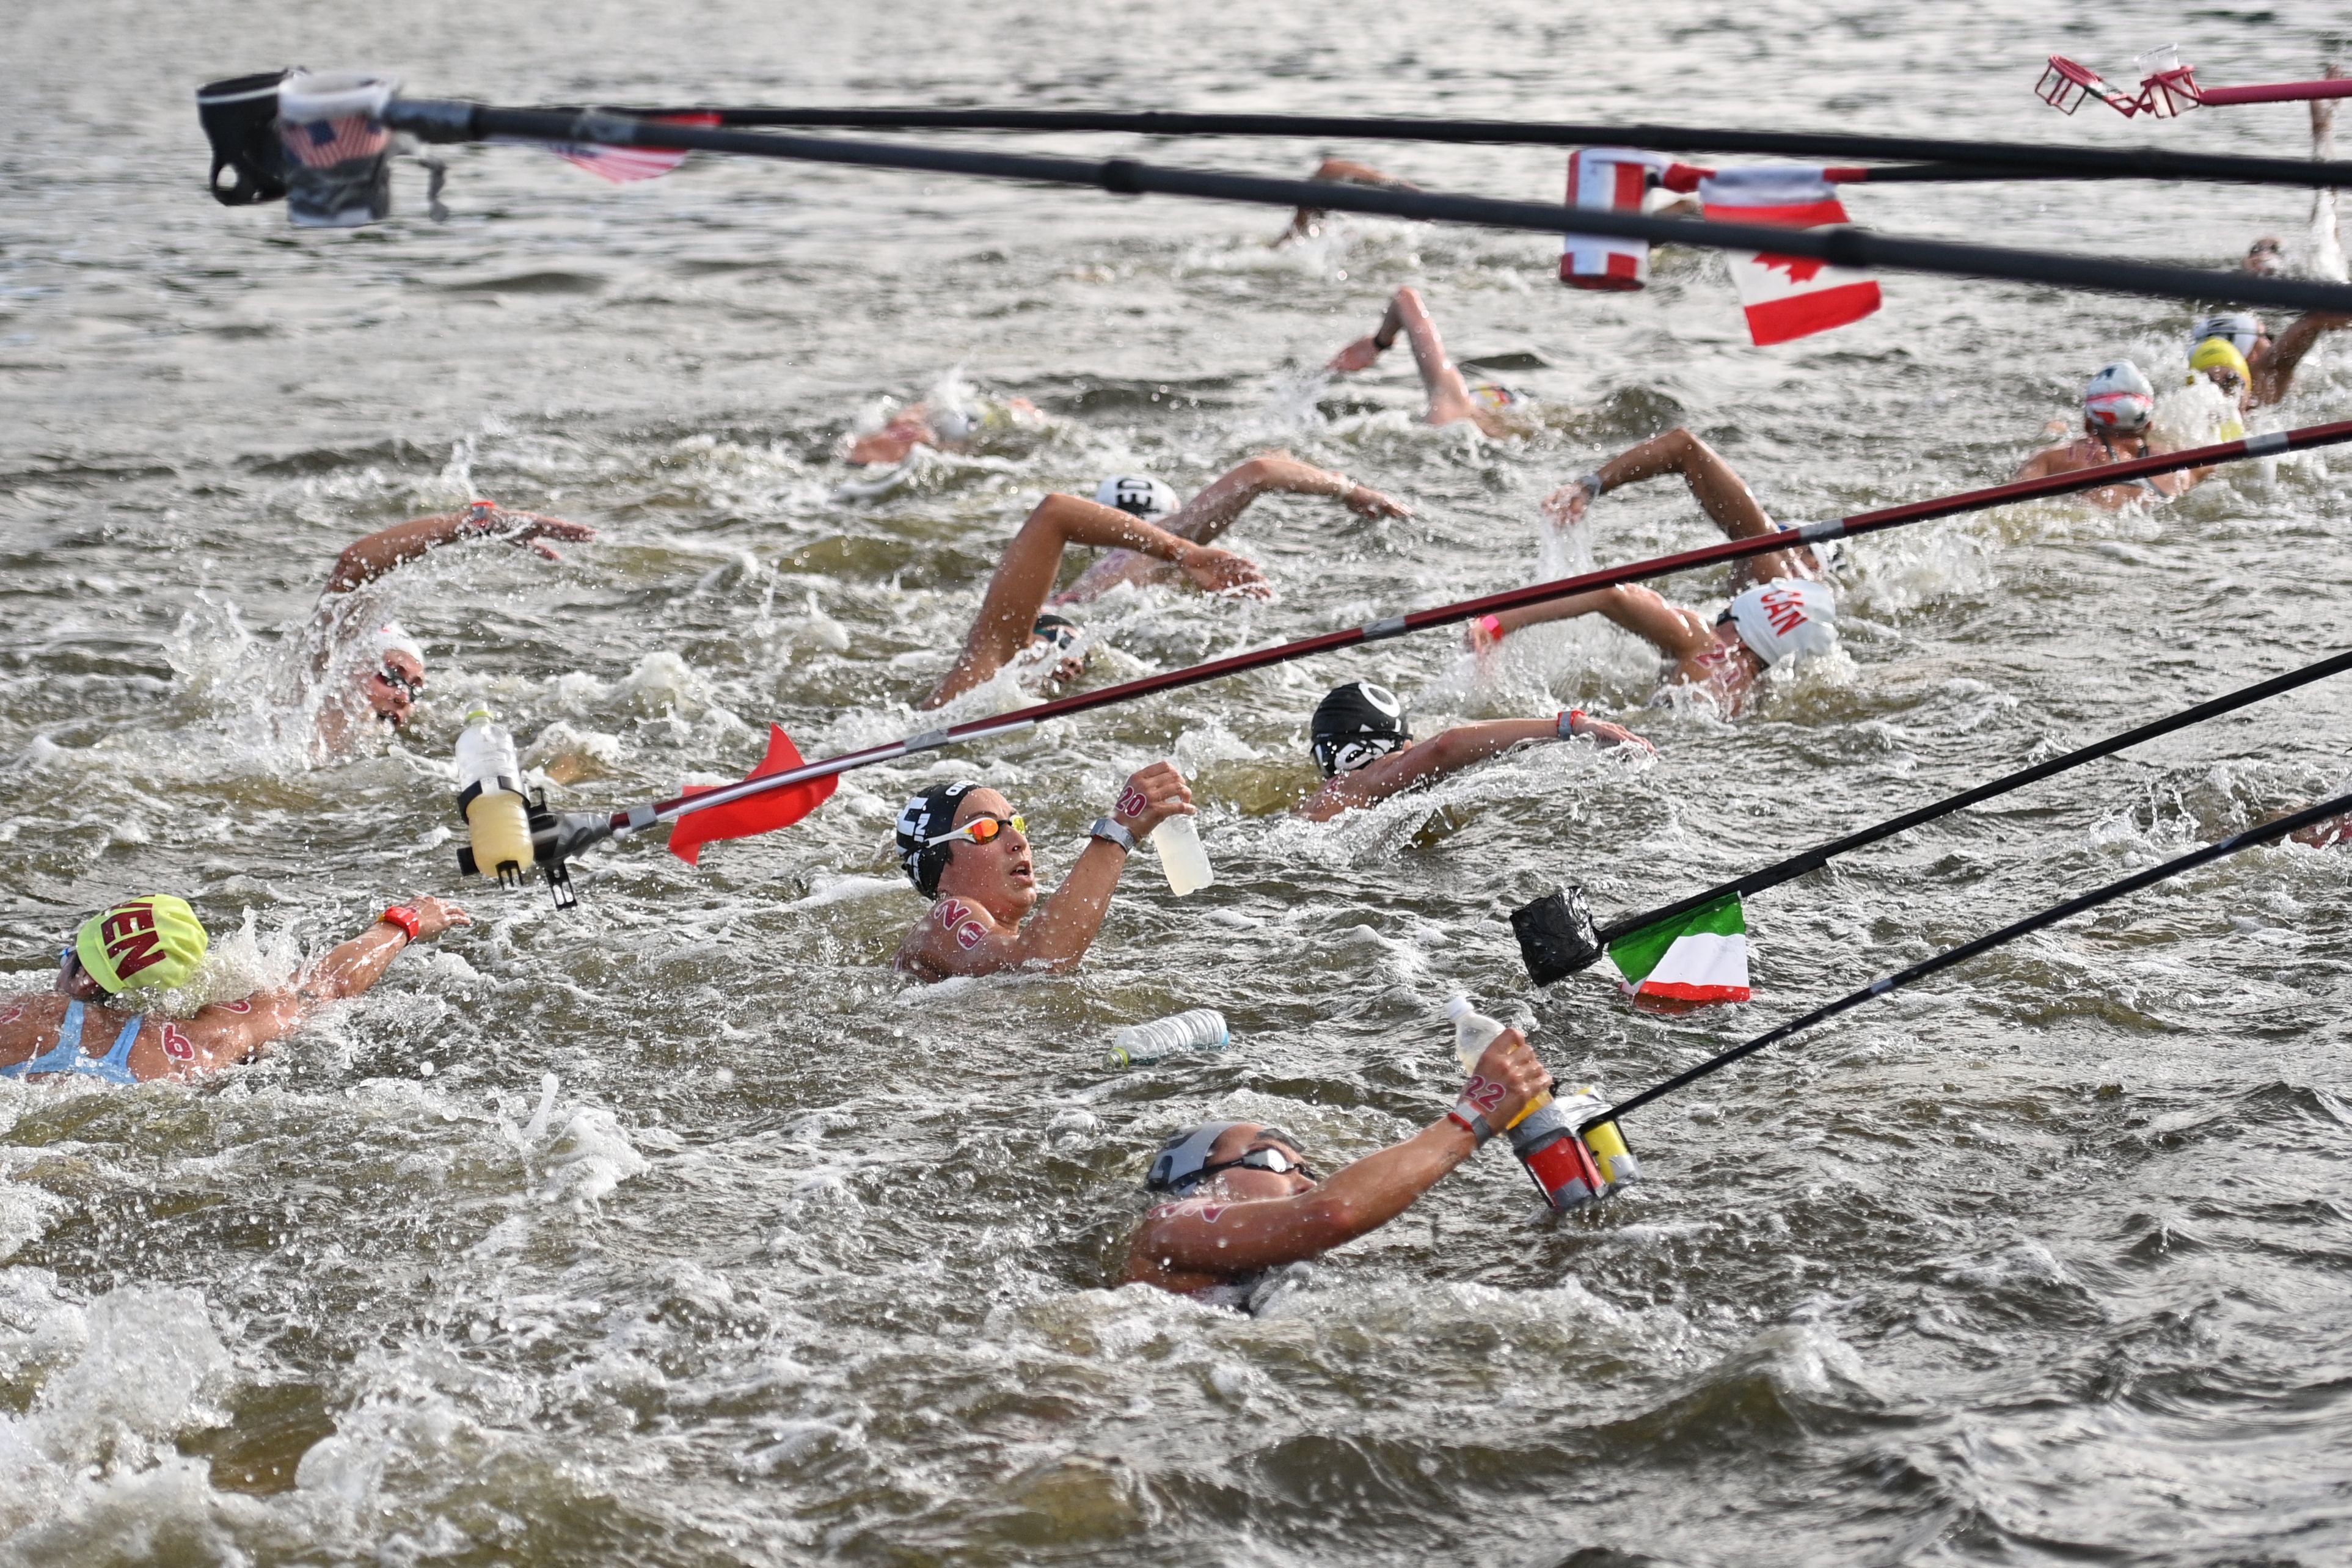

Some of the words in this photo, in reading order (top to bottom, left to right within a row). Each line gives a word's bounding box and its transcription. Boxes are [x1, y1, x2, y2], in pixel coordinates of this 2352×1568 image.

[1761, 589, 1808, 637] CAN
[1114, 786, 1147, 818] 20
[933, 899, 989, 950] 20
[1464, 1075, 1507, 1112] 22
